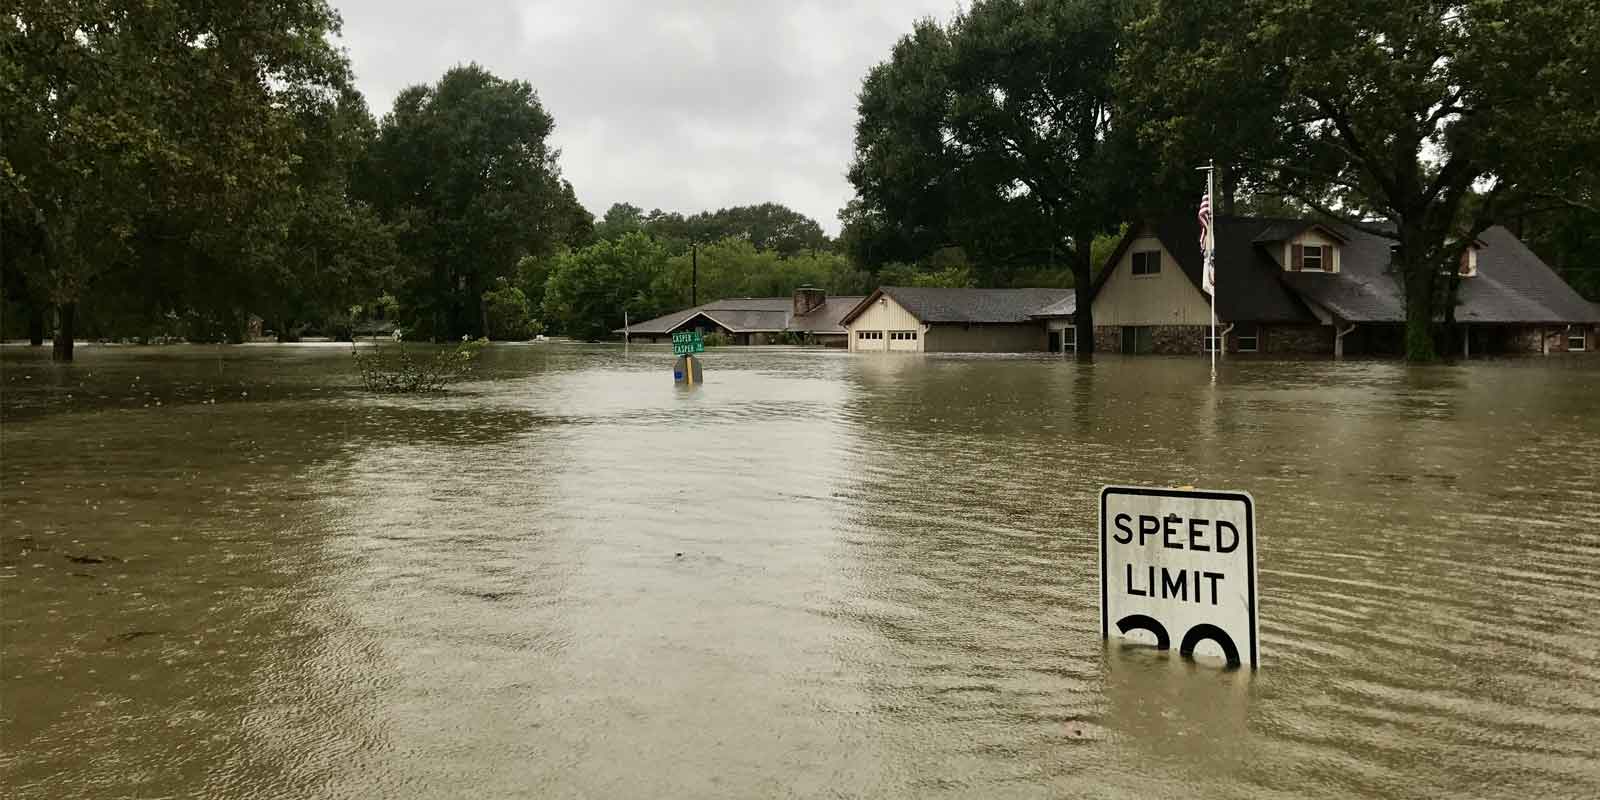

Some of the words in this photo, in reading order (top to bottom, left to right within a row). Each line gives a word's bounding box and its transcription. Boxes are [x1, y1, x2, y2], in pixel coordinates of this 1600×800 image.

[673, 334, 692, 343] CASPER
[675, 345, 694, 353] CASPER
[1113, 513, 1240, 553] SPEED
[1126, 563, 1225, 605] LIMIT
